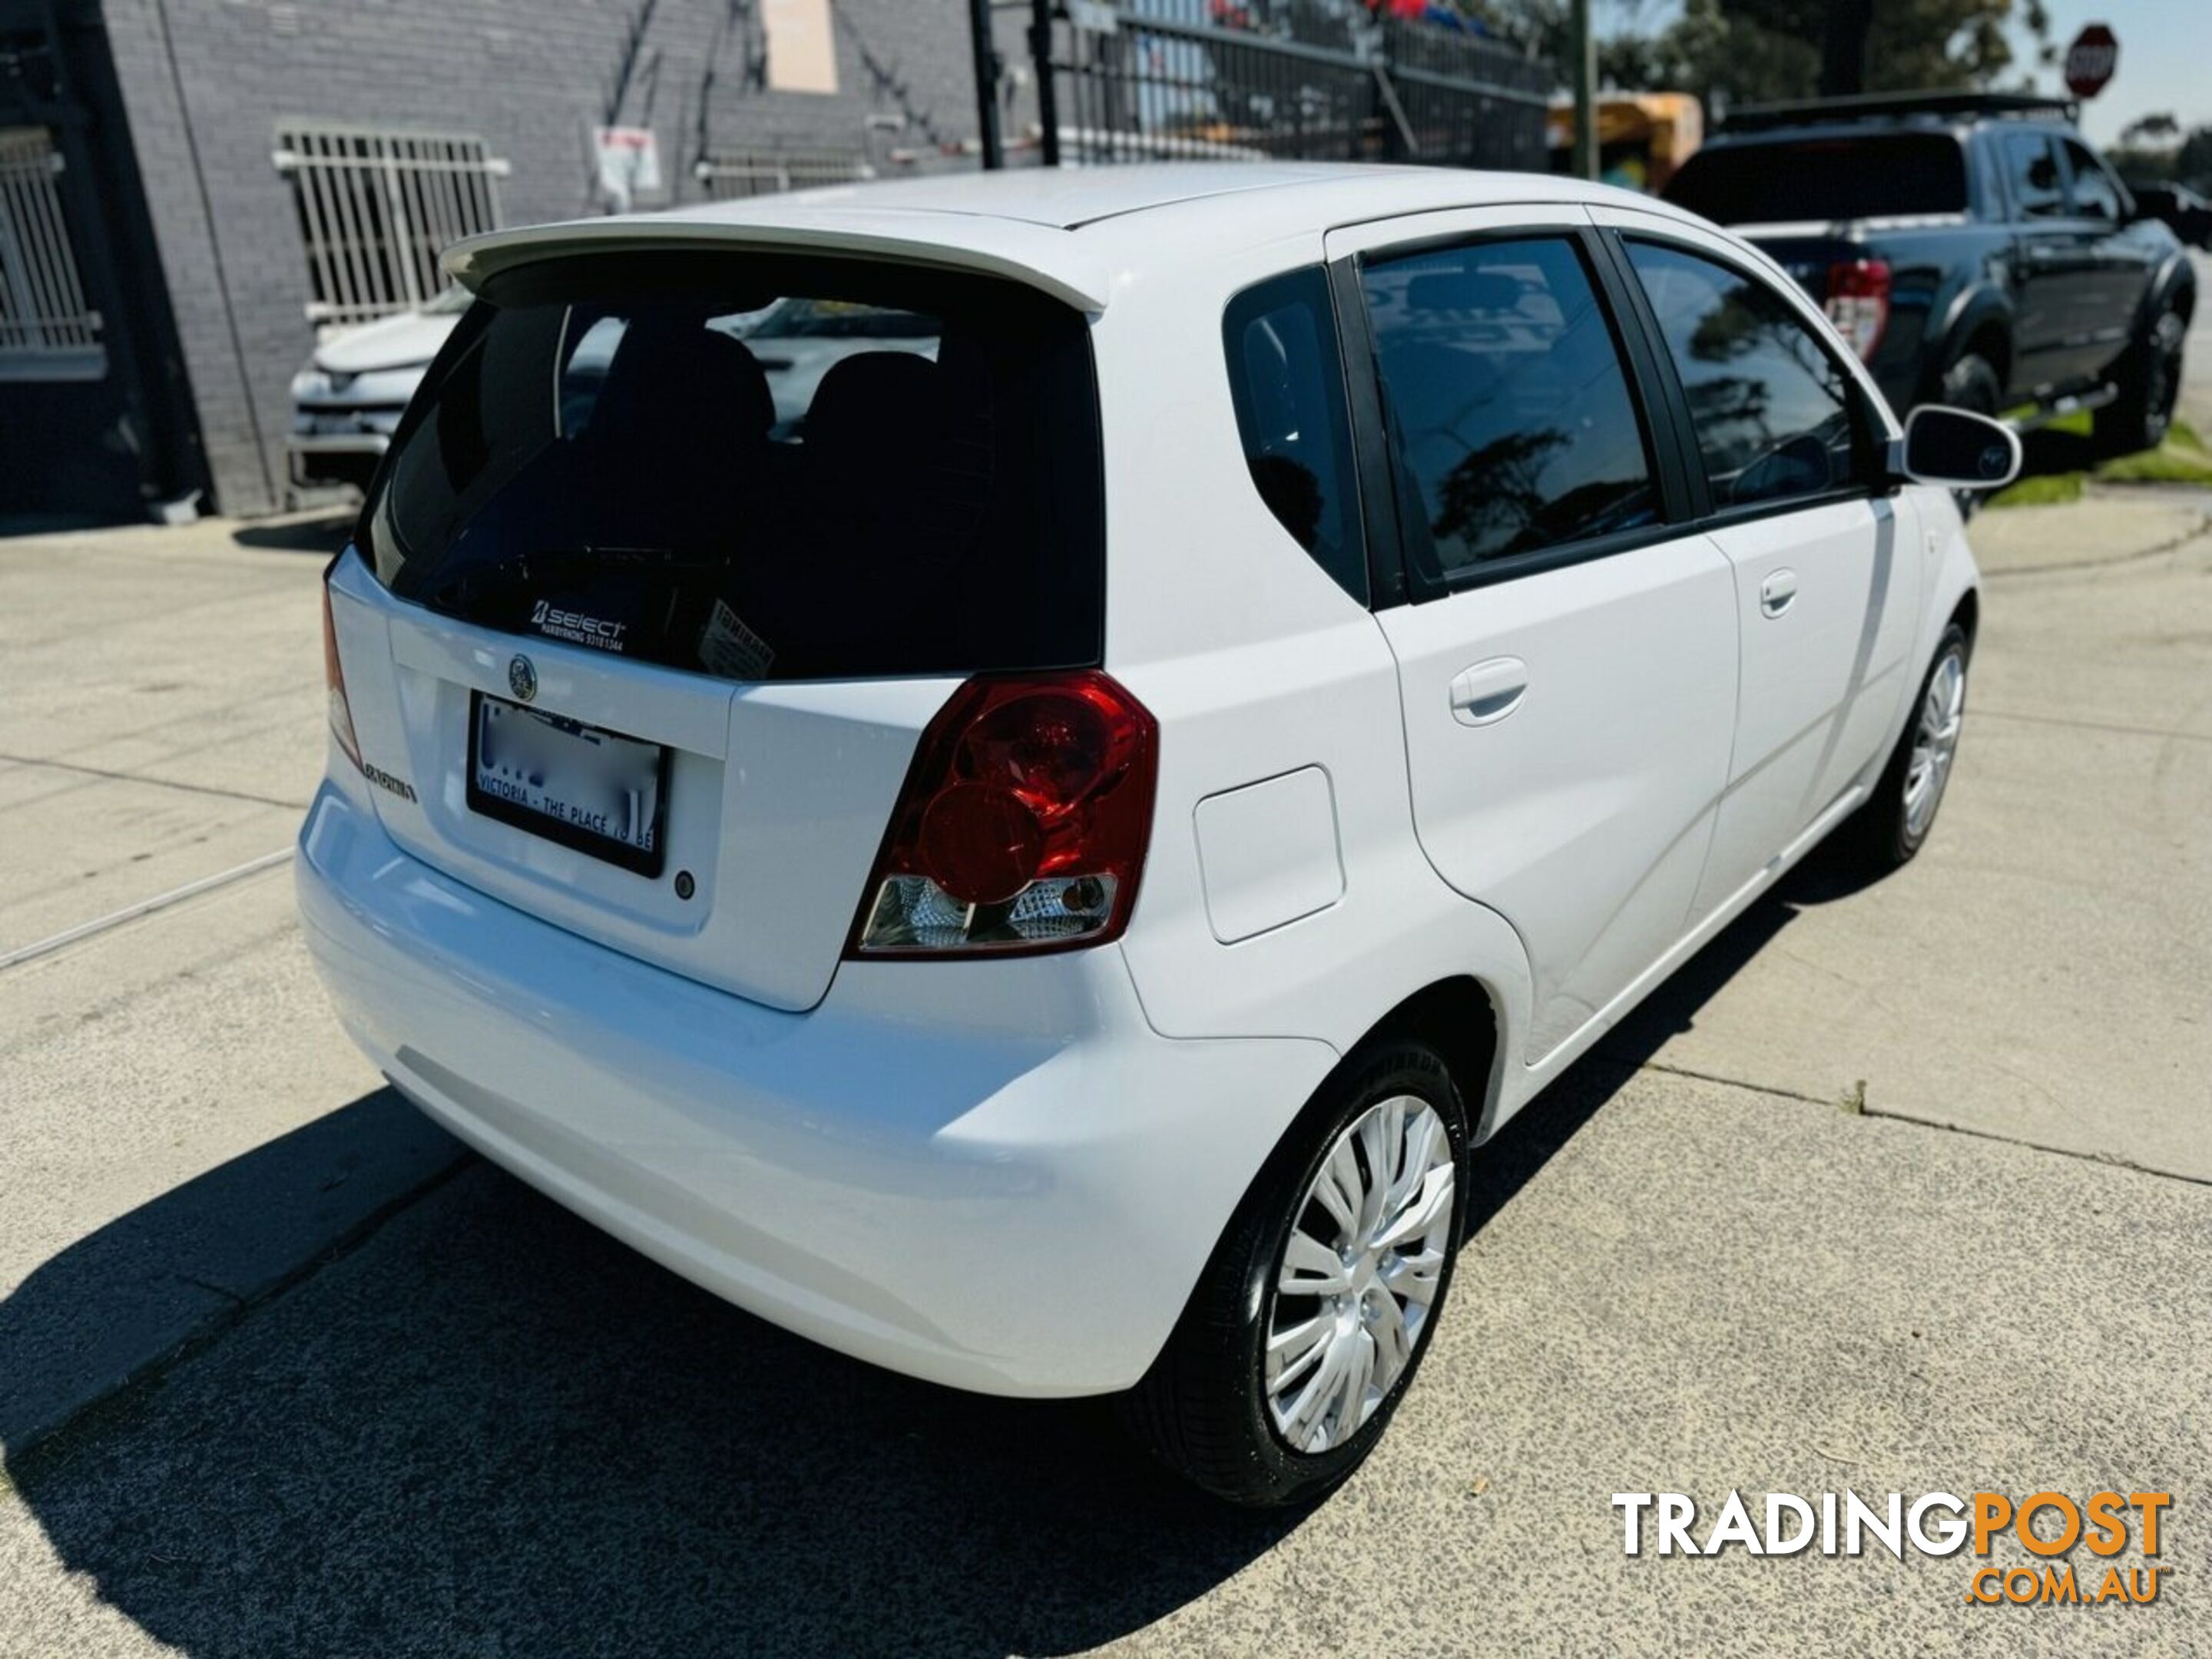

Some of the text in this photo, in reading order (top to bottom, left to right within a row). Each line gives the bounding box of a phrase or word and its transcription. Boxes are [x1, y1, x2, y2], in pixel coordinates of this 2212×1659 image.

[2068, 47, 2116, 80] STOP
[480, 774, 528, 804] VICTORIA
[544, 797, 565, 819] THE
[571, 806, 608, 833] PLACE
